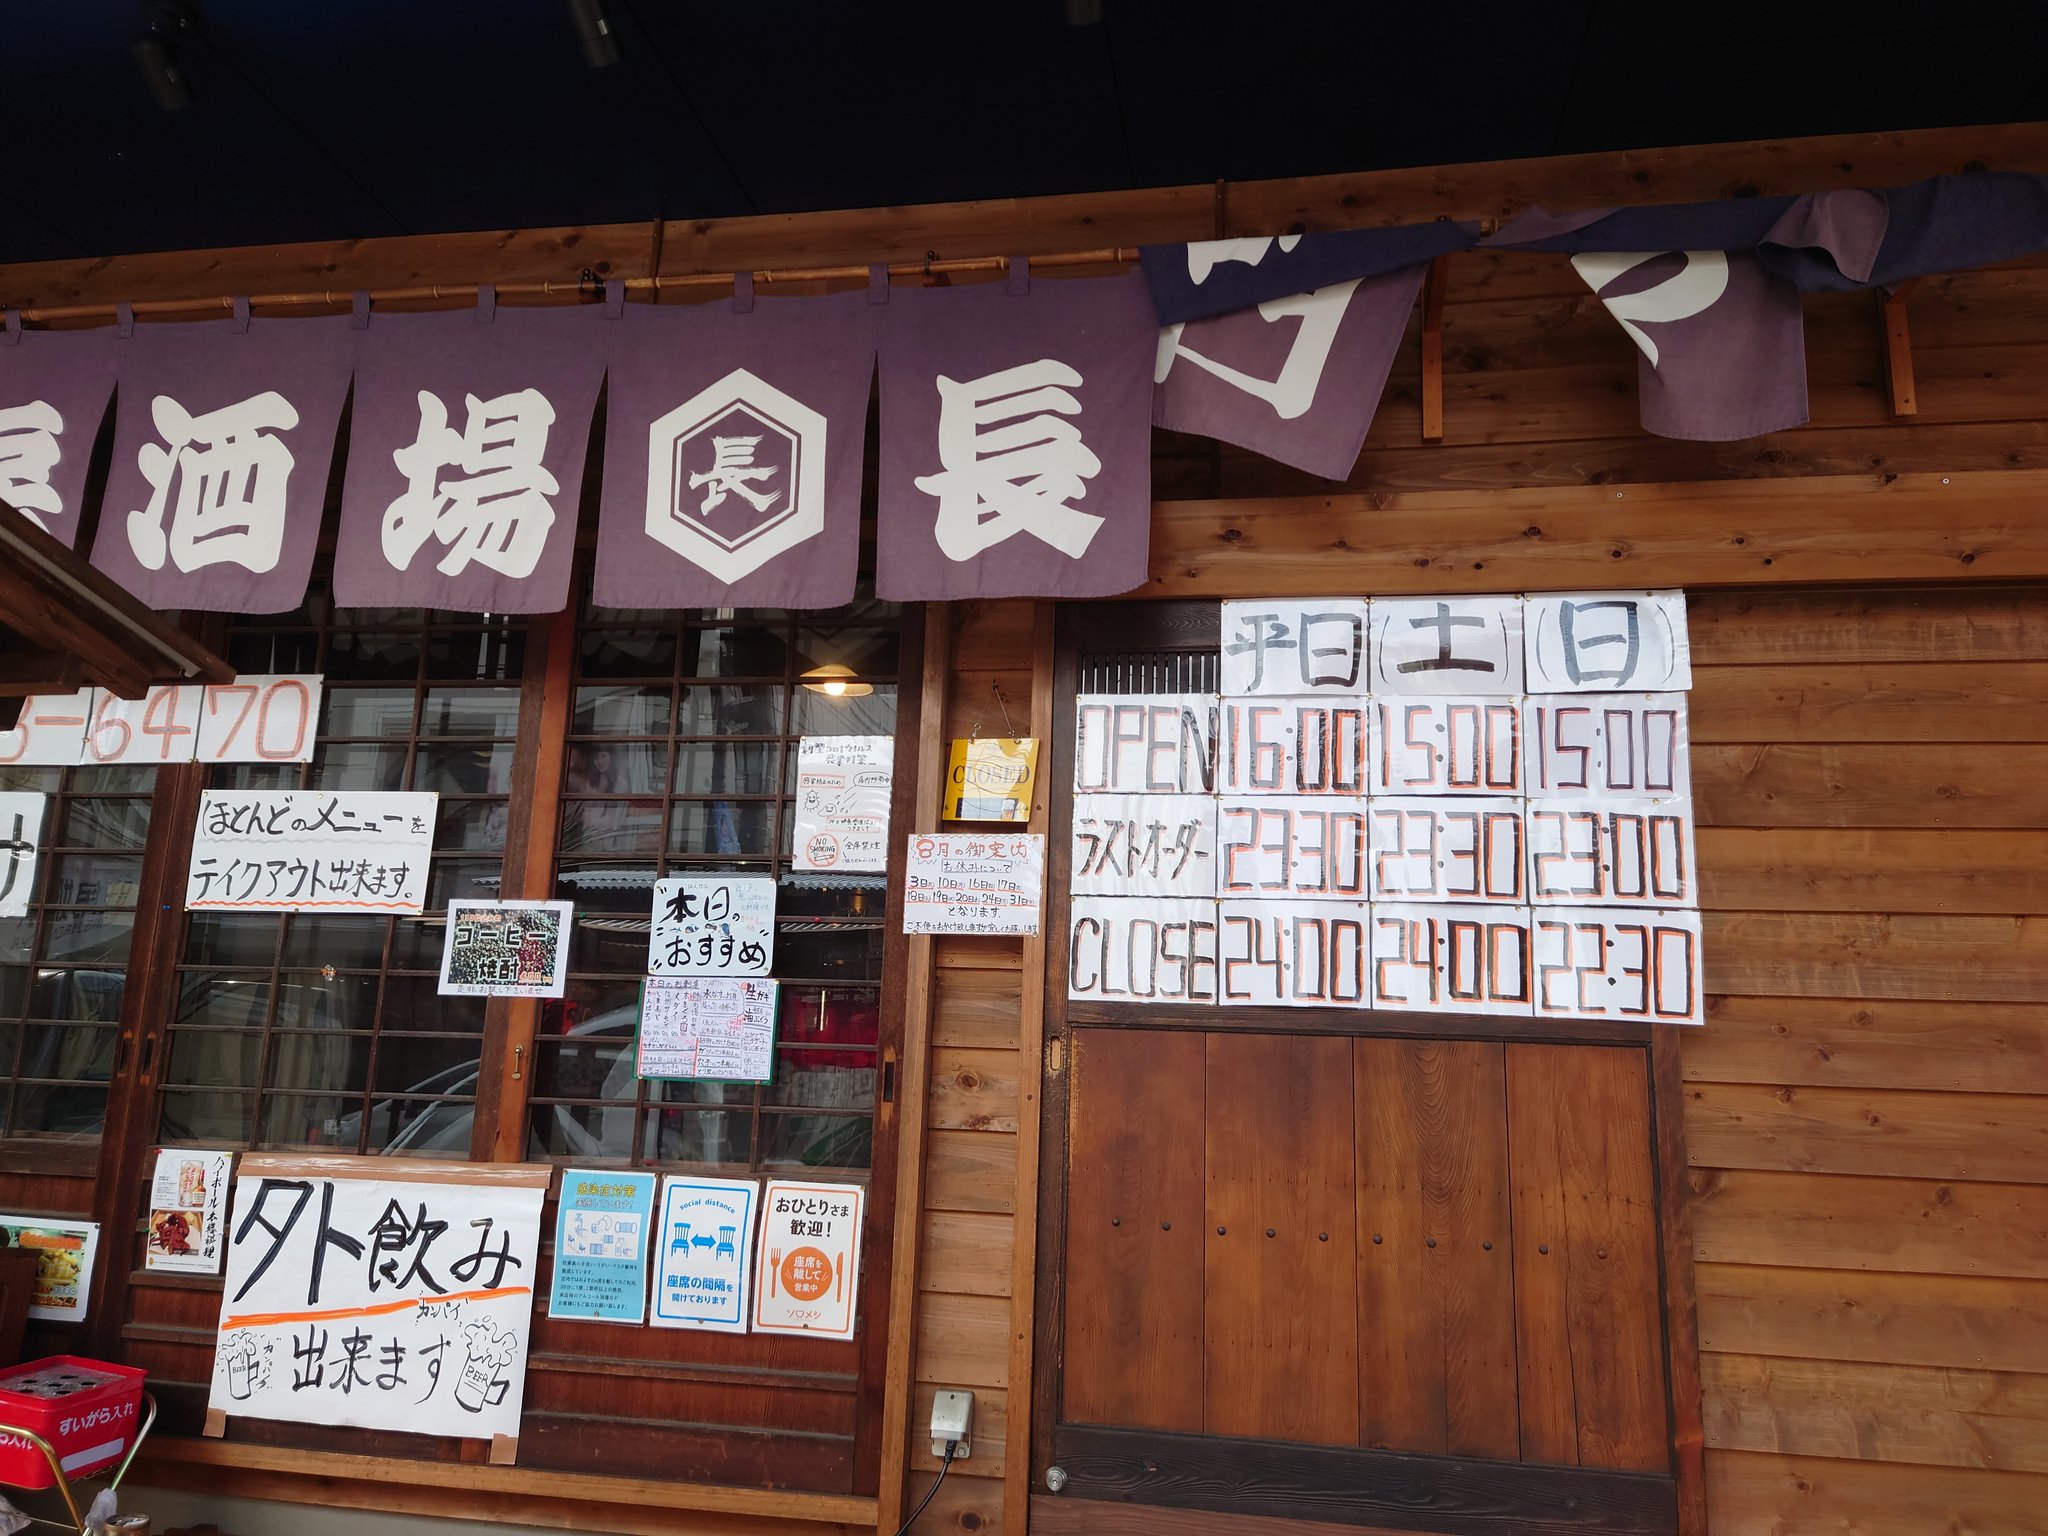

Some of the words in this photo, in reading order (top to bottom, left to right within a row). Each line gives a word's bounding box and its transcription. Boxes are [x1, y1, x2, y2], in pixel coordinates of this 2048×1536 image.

[913, 358, 1107, 563] 長
[688, 434, 783, 517] 長
[1223, 611, 1363, 695] 平日
[1077, 703, 1218, 794] OPEN
[1226, 703, 1363, 793] 16:00
[1378, 702, 1520, 791] 15:00
[1536, 706, 1678, 792] 15:00
[953, 764, 1031, 784] CLOSED
[201, 795, 430, 836] ほとんどのメニューを
[809, 845, 836, 854] SMOKING
[815, 838, 828, 847] NO
[915, 838, 1029, 860] 8月の御案内
[1076, 818, 1210, 881] ラストオーダー
[1222, 806, 1366, 895] 23:30
[1374, 808, 1524, 899] 23:30
[1533, 809, 1686, 900] 23:00
[943, 861, 1012, 873] お休みについて
[191, 857, 414, 902] テイクアウト出来ます。
[658, 886, 741, 924] 本日の
[948, 906, 1001, 919] となります。
[456, 924, 549, 947] コーヒー
[665, 934, 767, 971] おすすめ
[478, 958, 521, 981] 焼酎
[519, 971, 542, 984] 400
[1071, 917, 1216, 1002] CLOSE
[1224, 915, 1365, 1003] 24:00
[1374, 917, 1532, 1006] 24:00
[1538, 921, 1695, 1020] 22:30
[577, 1182, 638, 1198] 感染症対策
[679, 1198, 702, 1211] social
[704, 1198, 736, 1215] distance
[775, 1197, 850, 1218] おひとりさま
[790, 1218, 833, 1238] 歓迎!
[232, 1178, 523, 1306] 外飲み
[793, 1255, 823, 1269] 座席を
[667, 1274, 734, 1293] 座席の間隔を
[792, 1268, 822, 1281] 離して
[794, 1282, 818, 1293] 営業中
[671, 1293, 728, 1306] 開けております
[291, 1323, 452, 1405] 出来ます
[464, 1365, 490, 1386] BEER
[59, 1402, 135, 1437] すいがら入れ
